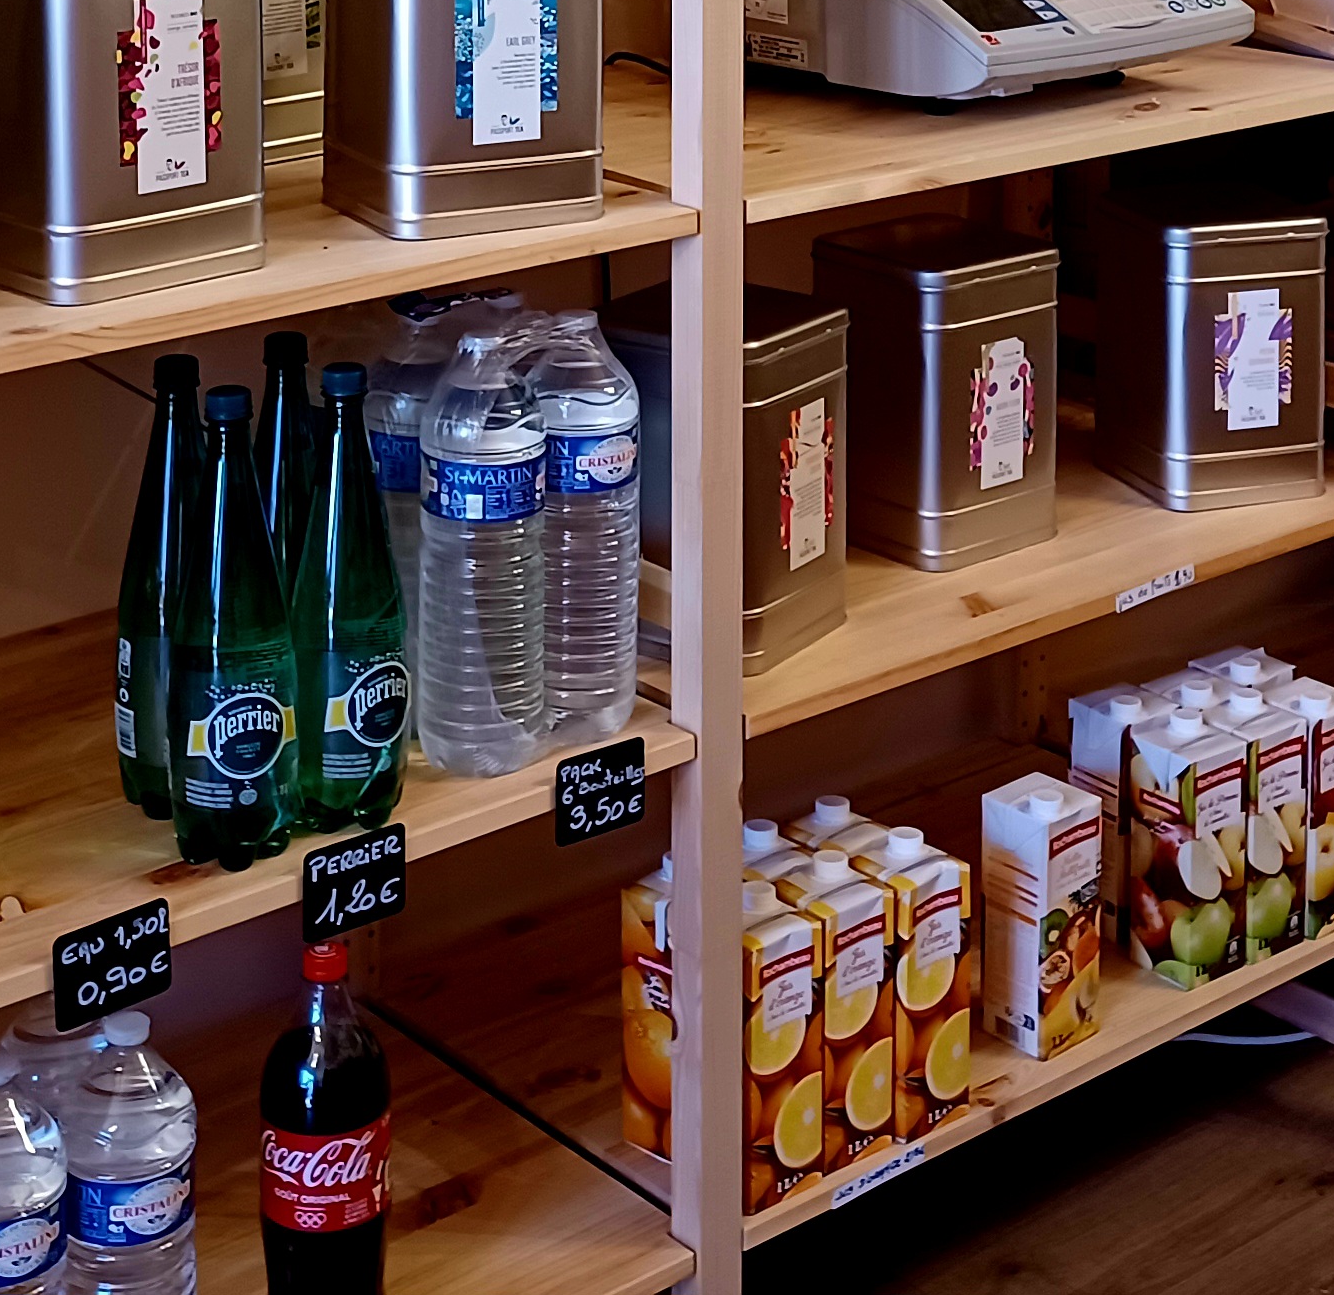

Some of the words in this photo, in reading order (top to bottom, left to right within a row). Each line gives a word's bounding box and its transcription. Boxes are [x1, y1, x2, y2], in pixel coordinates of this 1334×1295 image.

[560, 758, 602, 784] PACK
[561, 785, 575, 805] 6
[569, 793, 643, 833] 3,50€
[314, 877, 401, 926] 1,20€
[60, 936, 105, 965] EAU
[78, 951, 169, 1006] 0,90€
[261, 1128, 376, 1188] Coca-Cola
